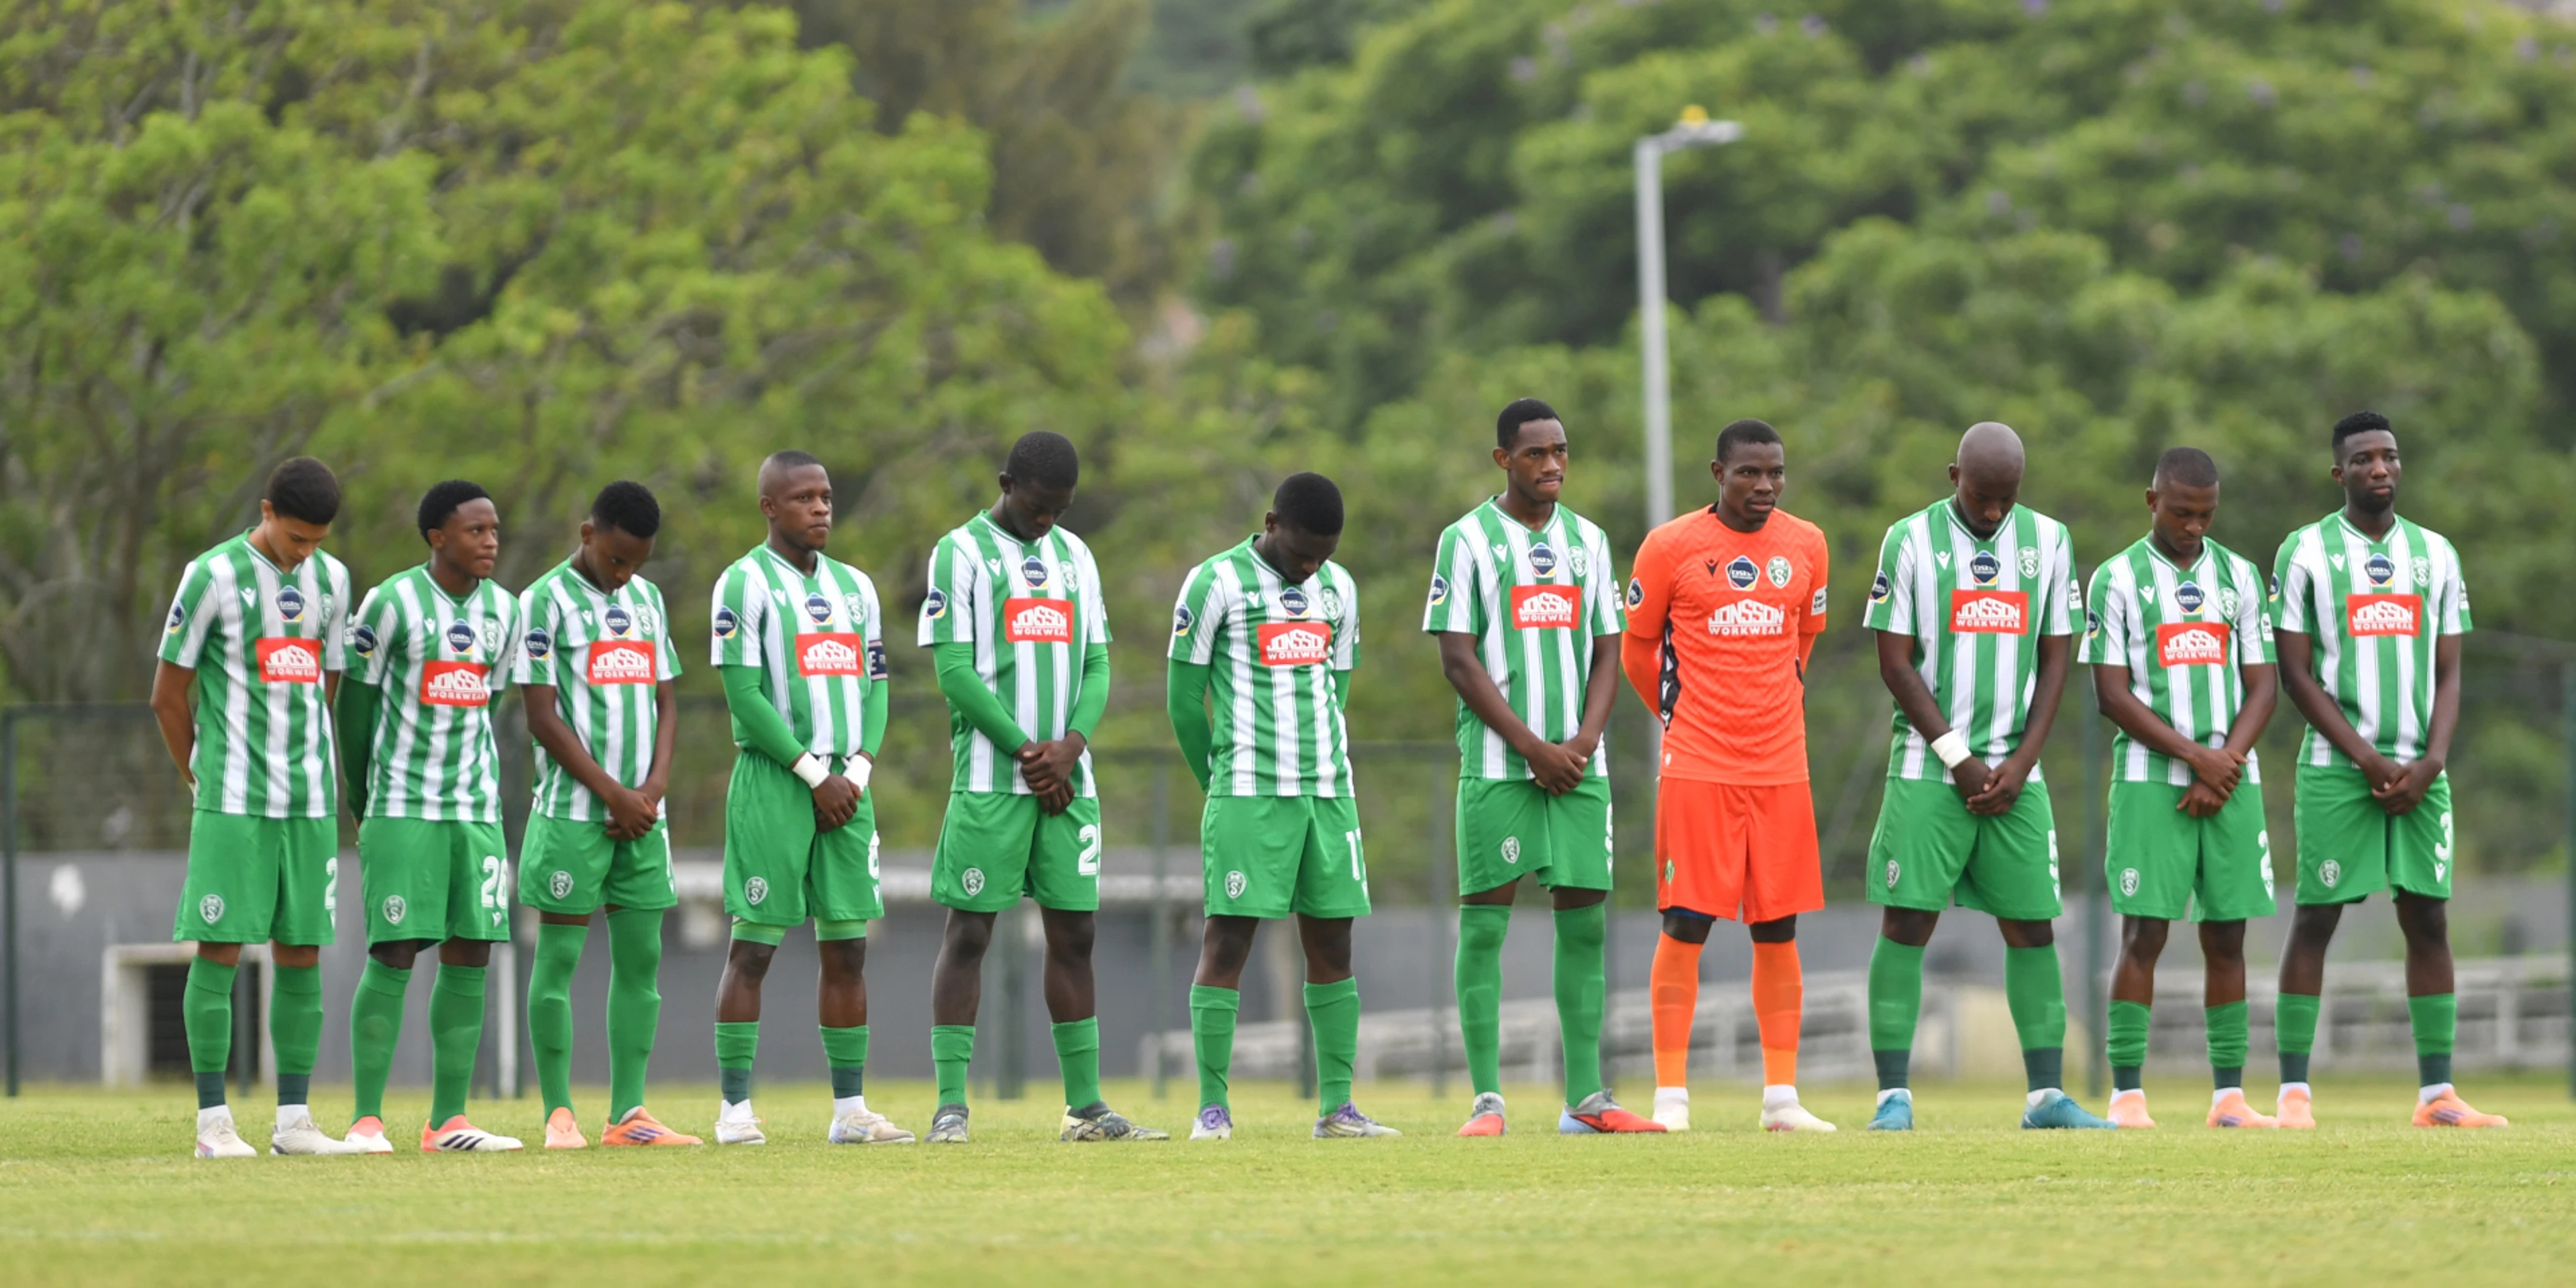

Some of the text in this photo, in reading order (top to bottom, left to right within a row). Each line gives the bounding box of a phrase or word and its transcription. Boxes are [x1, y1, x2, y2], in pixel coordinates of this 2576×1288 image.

[1708, 598, 1784, 624] JONSSON
[1956, 597, 2021, 619] JONSSON
[2352, 600, 2414, 622] JONSSON
[1709, 626, 1783, 635] WORKWEAR
[1956, 619, 2020, 629] WORKWEAR
[592, 647, 650, 669] JONSSON
[2434, 812, 2450, 860] 3
[1079, 822, 1101, 875] 2
